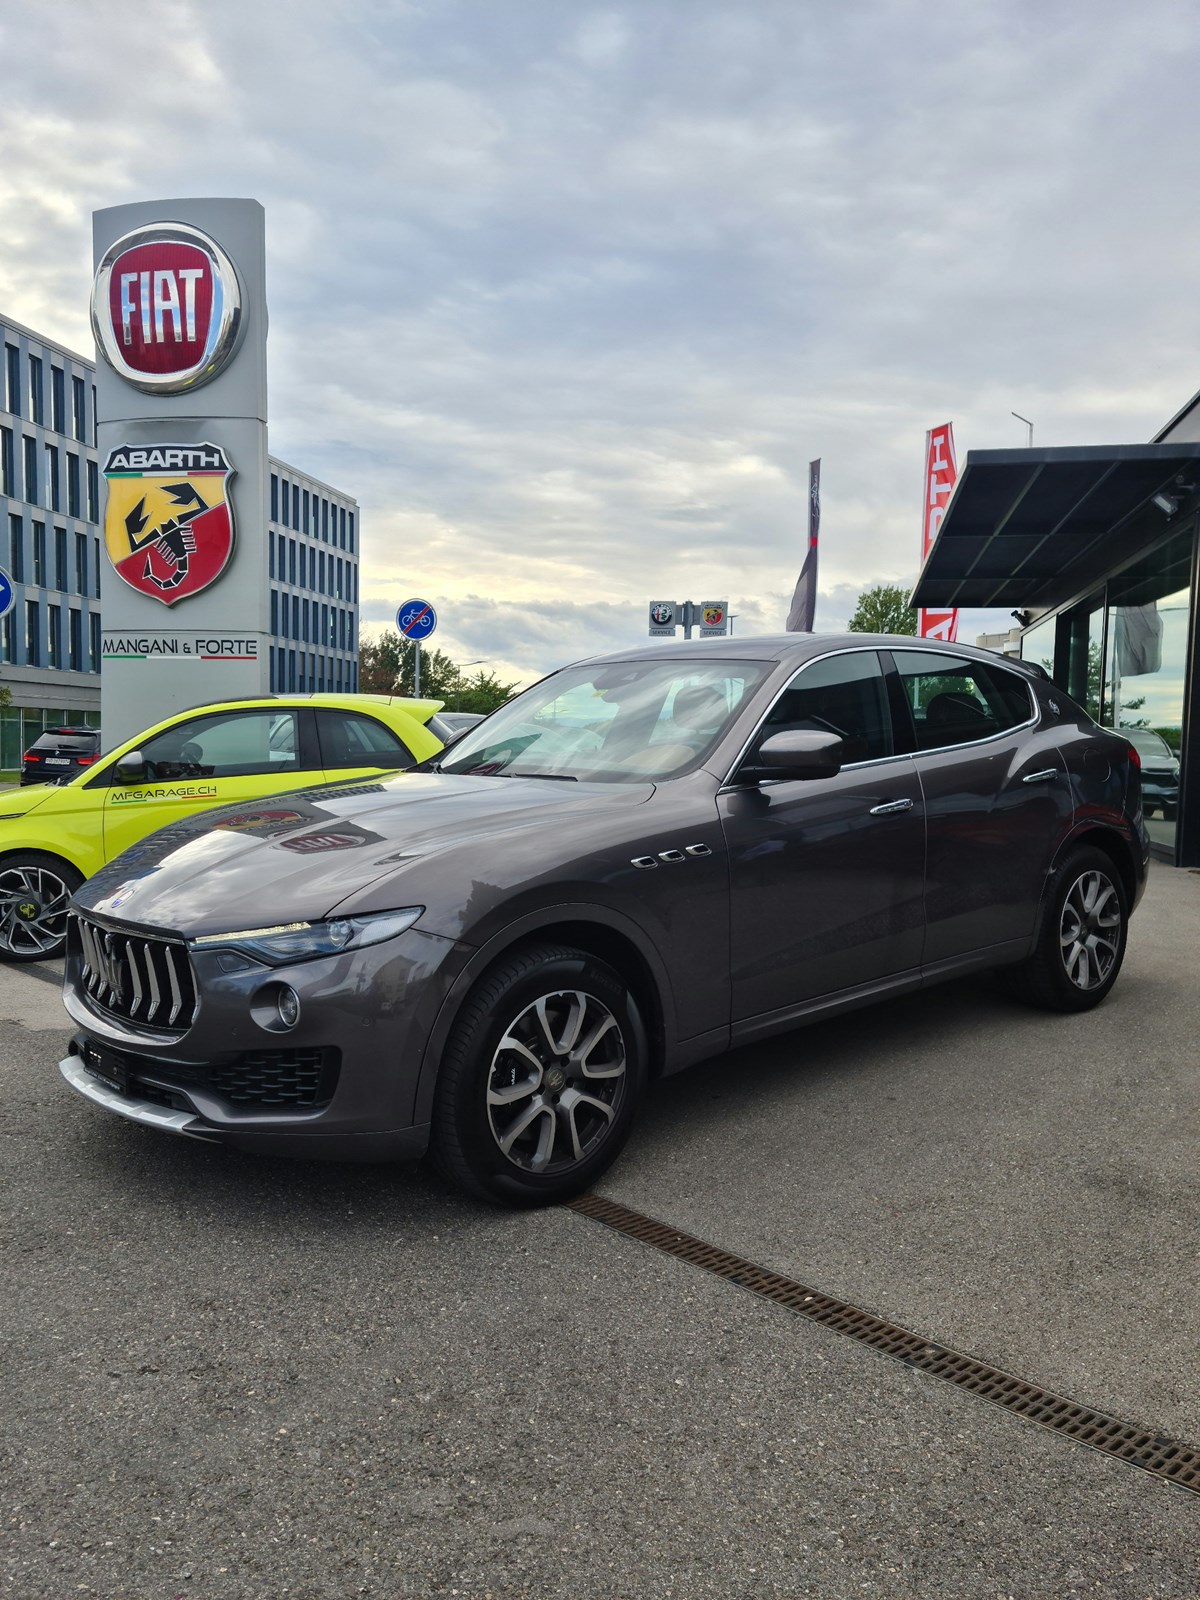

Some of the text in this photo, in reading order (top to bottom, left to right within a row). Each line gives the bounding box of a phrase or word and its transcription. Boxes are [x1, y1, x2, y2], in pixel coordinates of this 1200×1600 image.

[120, 268, 204, 346] FIAT
[109, 449, 220, 469] ABARTH
[102, 639, 258, 654] MANGANI & FORTE
[111, 785, 217, 801] MFGARAGE.CH
